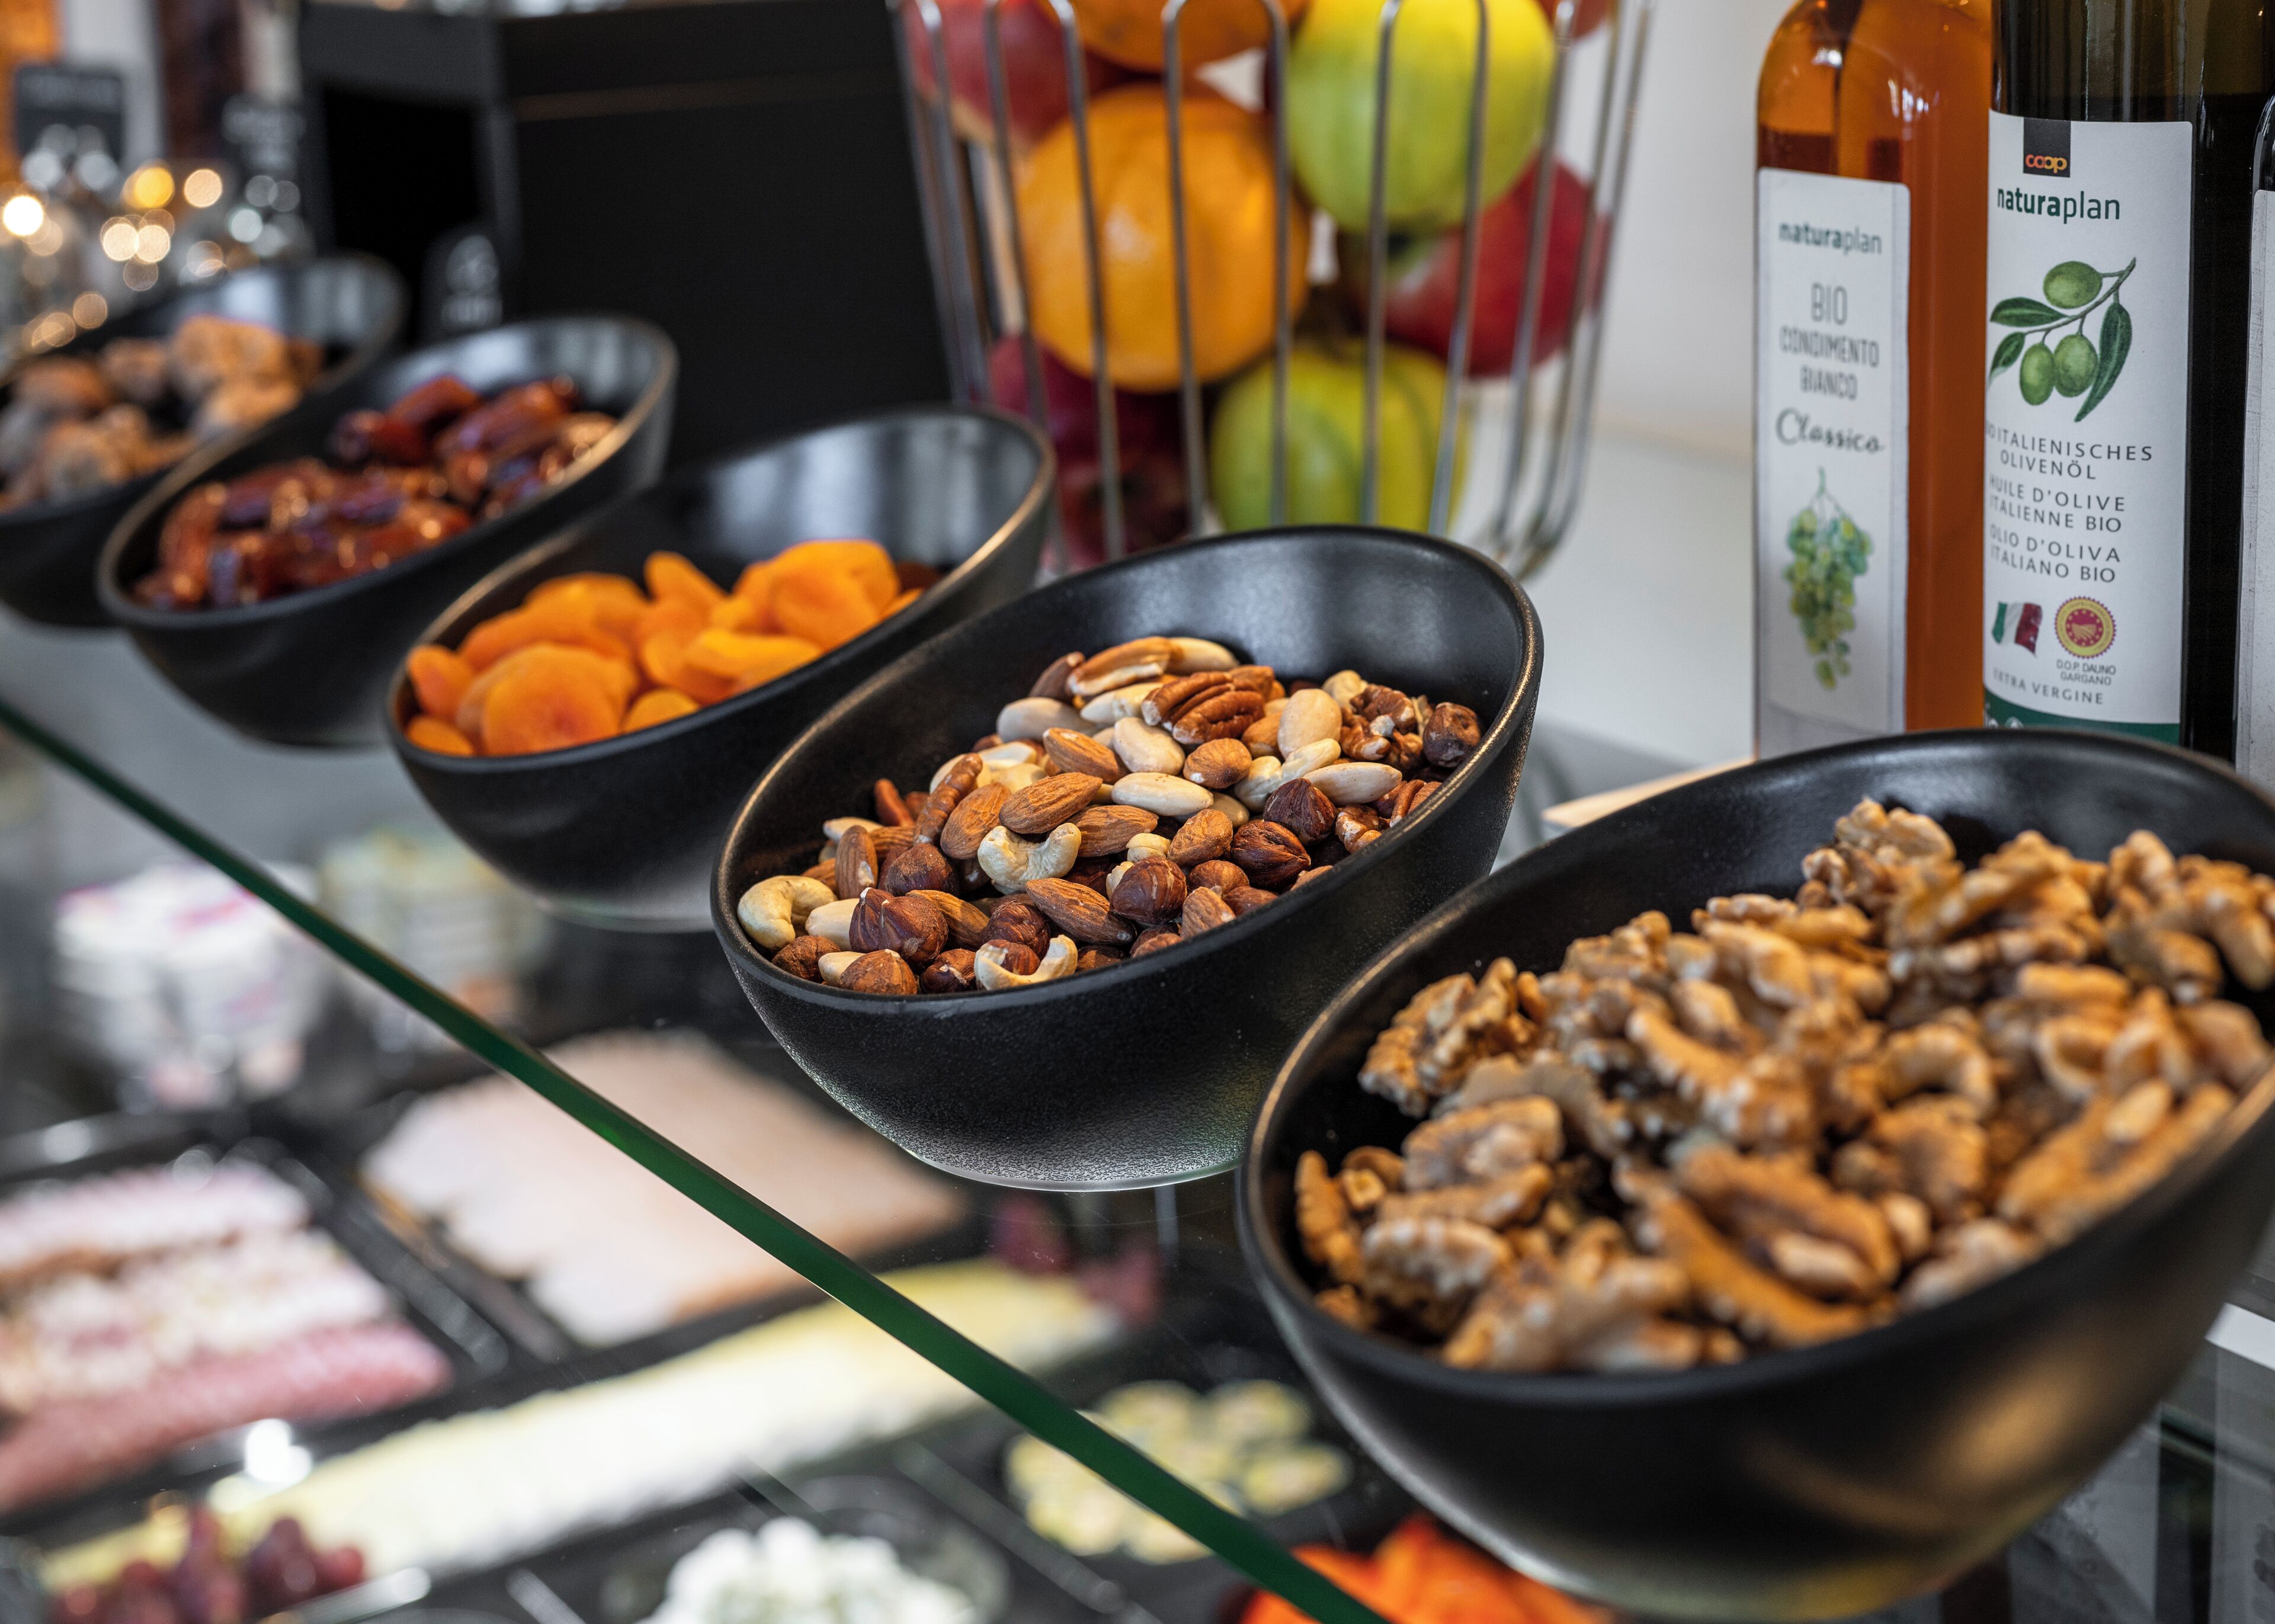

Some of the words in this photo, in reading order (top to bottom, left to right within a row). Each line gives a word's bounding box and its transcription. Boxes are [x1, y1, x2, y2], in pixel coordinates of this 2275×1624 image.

[2025, 154, 2068, 174] coop
[1997, 187, 2120, 225] naturaplan
[1779, 222, 1882, 256] naturaplan
[1811, 282, 1848, 326] BIO
[1780, 326, 1880, 368] CONDIMENTO
[1800, 364, 1858, 400] BIANCO
[1776, 407, 1886, 454] Classico
[1997, 427, 2152, 461] ITALIENISCHES
[2000, 449, 2096, 479] OLIVENÖL
[1990, 494, 2074, 528] ITALIENNE
[2086, 516, 2122, 532] BIO
[2033, 487, 2125, 511] D'OLIVE
[1989, 524, 2019, 547] OLIO
[2027, 537, 2120, 563] D'OLIVA
[1991, 544, 2069, 578] ITALIANO
[2080, 566, 2116, 583] BIO
[2060, 671, 2113, 686] GARGANO
[2082, 662, 2117, 675] DAUNO
[2032, 682, 2103, 704] VERGINE
